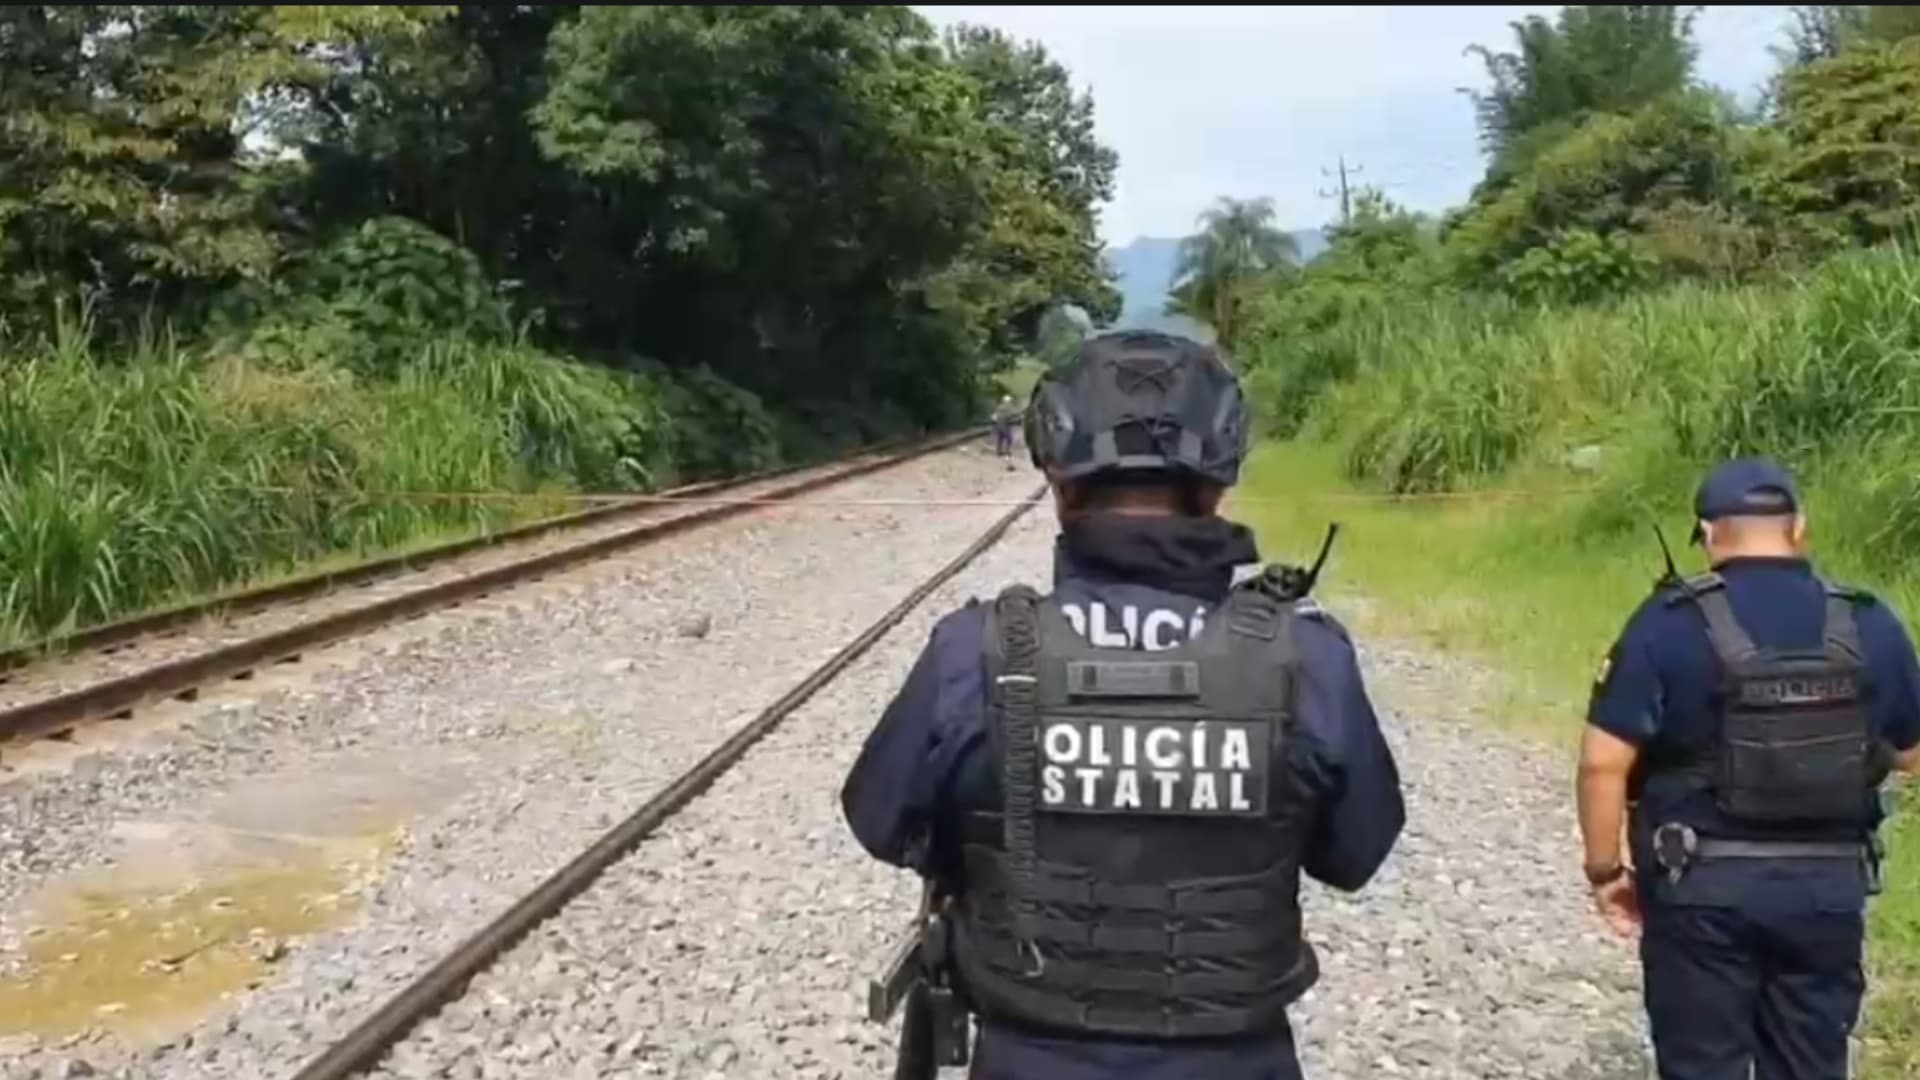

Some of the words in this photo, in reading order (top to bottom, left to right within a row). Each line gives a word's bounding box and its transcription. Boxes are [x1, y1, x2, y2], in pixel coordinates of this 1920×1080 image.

[1061, 601, 1207, 651] LICÍ
[1034, 720, 1251, 769] OLICÍA
[1041, 764, 1251, 810] STATAL
